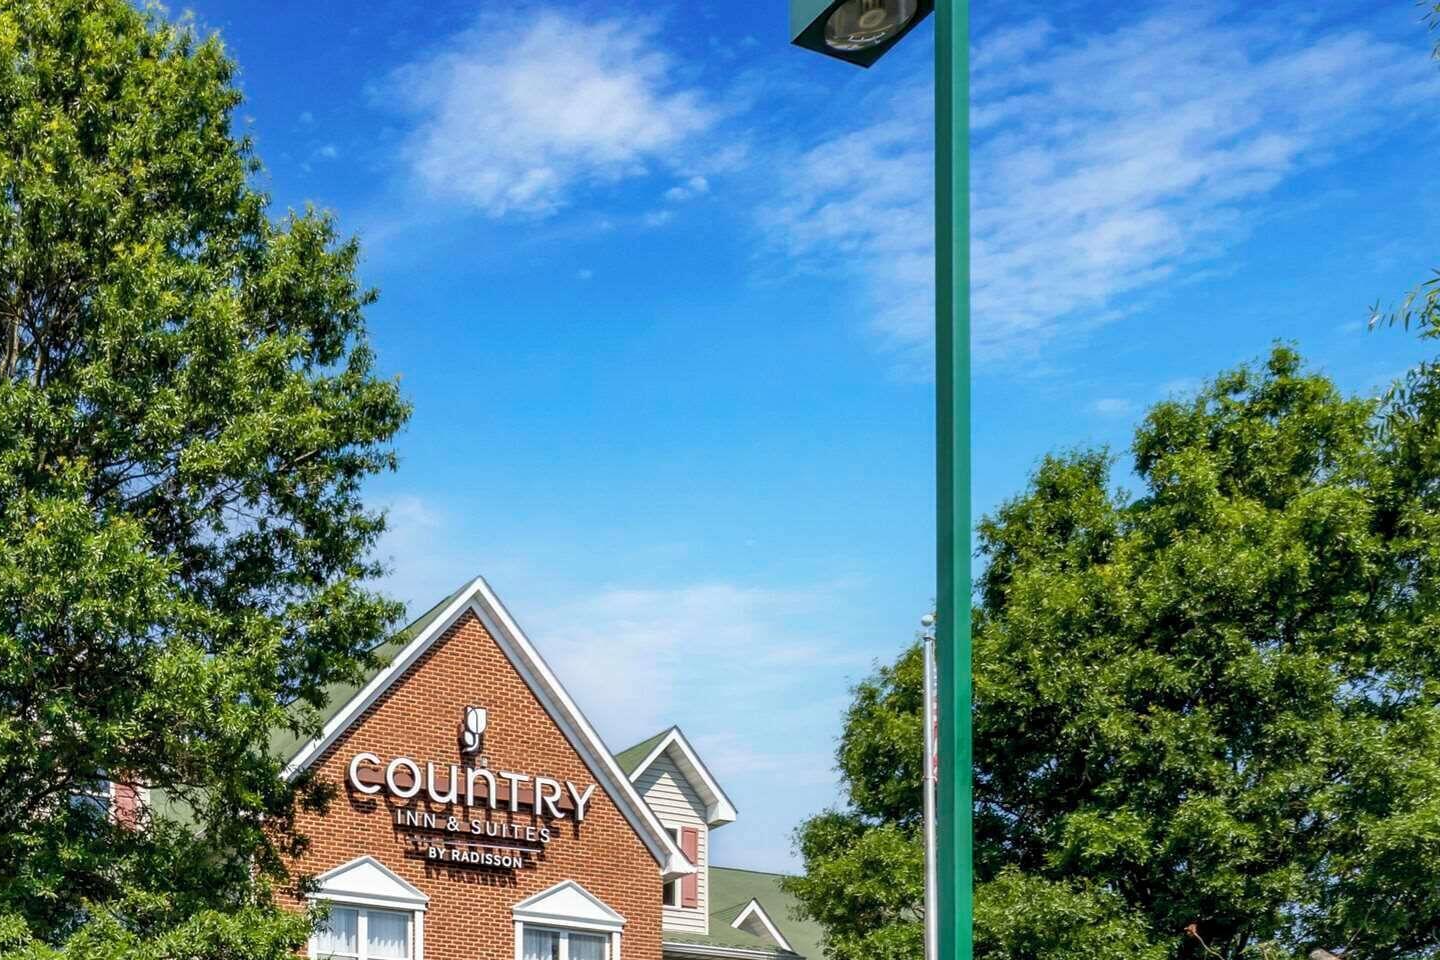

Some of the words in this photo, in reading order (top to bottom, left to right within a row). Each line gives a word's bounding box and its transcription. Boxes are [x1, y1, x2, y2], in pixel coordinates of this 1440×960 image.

[397, 809, 436, 828] INN
[446, 815, 460, 832] &
[471, 820, 551, 843] SUITES
[428, 847, 445, 859] BY
[452, 850, 522, 868] RADISSON
